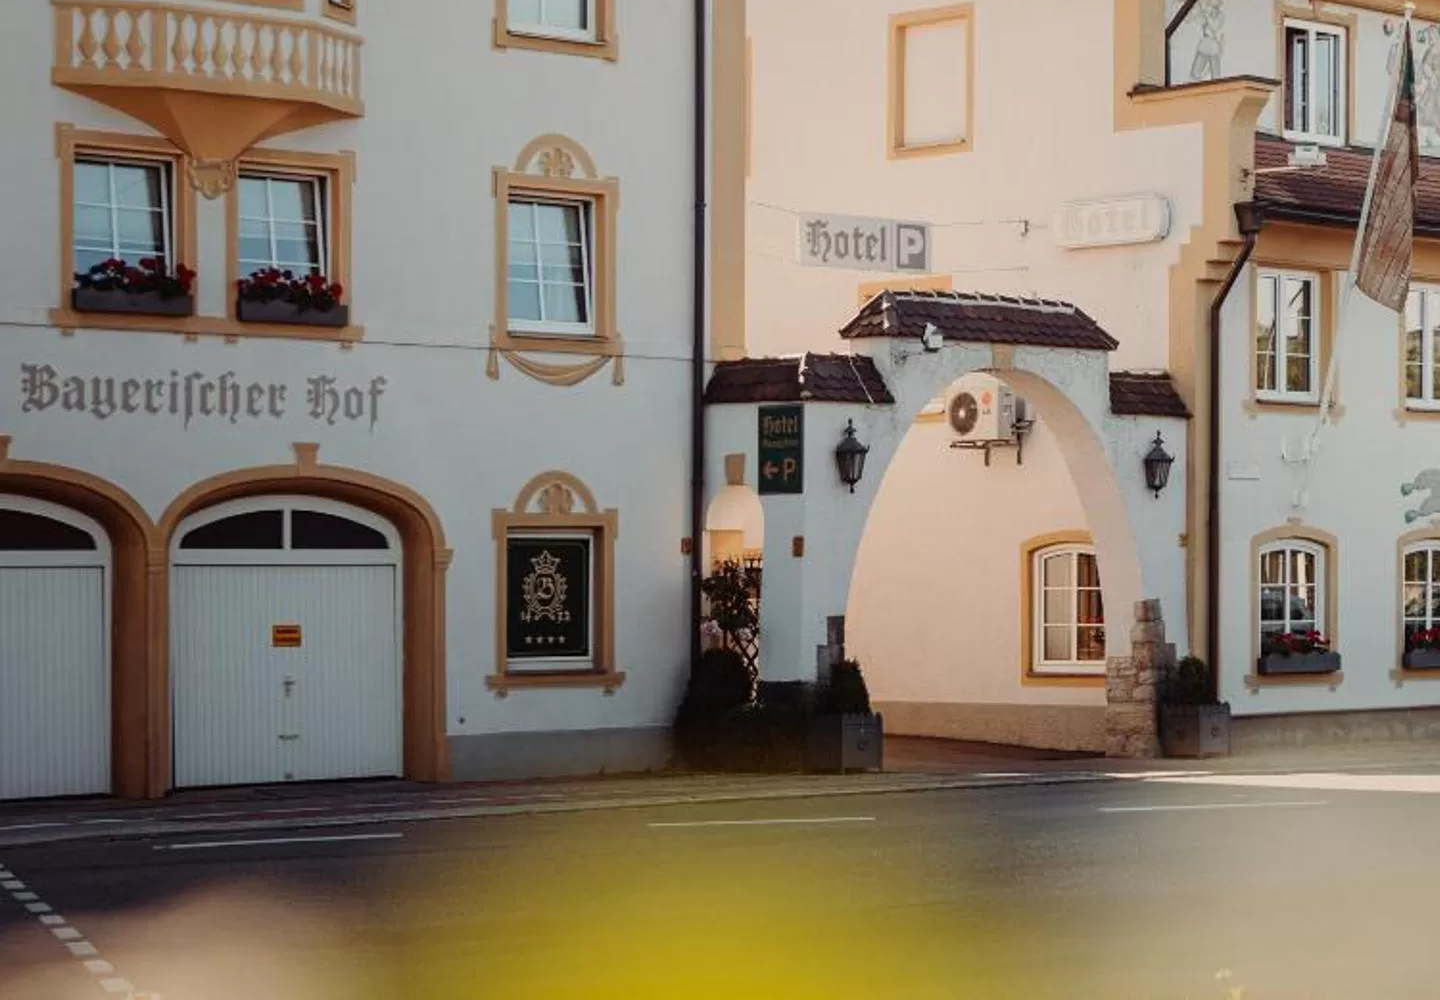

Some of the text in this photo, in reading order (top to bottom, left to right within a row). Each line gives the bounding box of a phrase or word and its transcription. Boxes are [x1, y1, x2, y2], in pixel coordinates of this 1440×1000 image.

[806, 220, 924, 266] Hotel P
[21, 363, 388, 433] Bayerischer Hof
